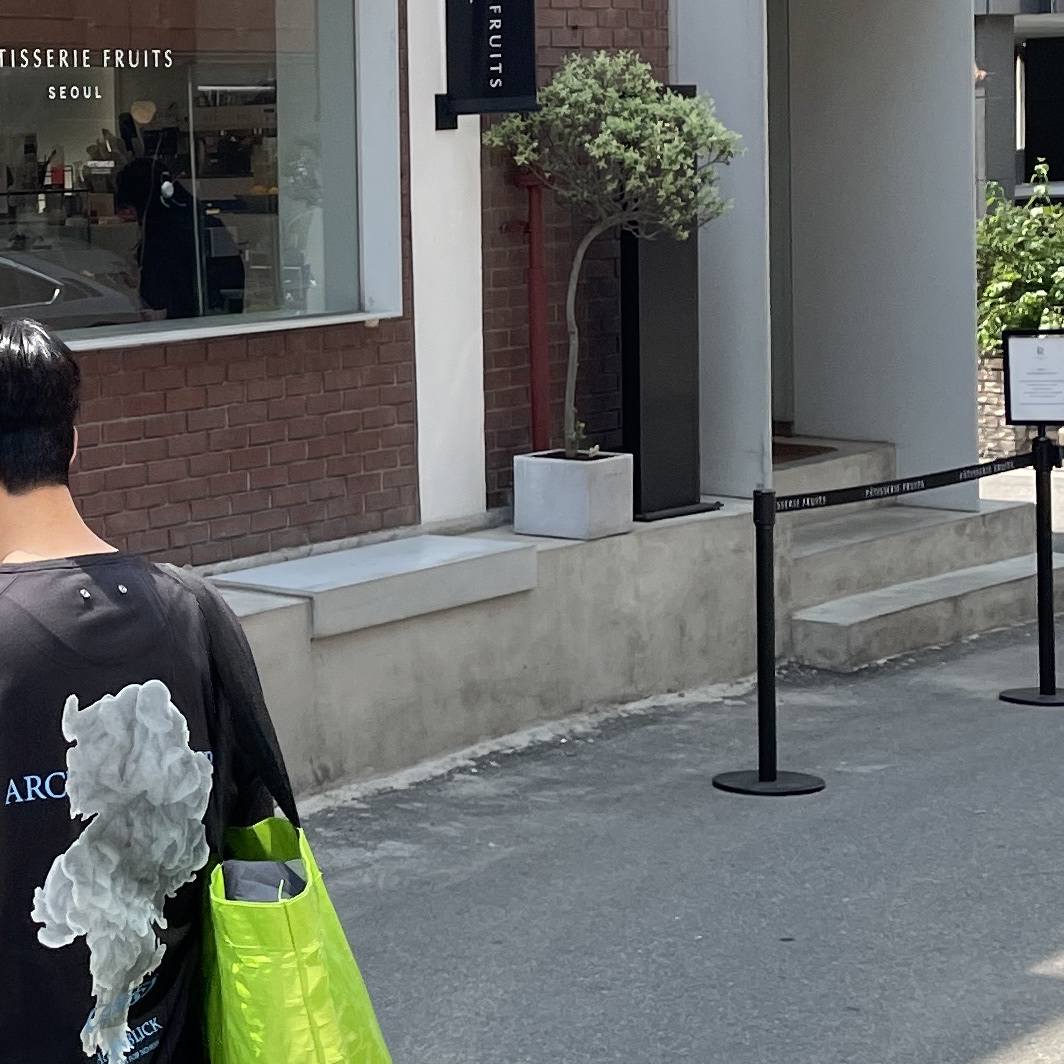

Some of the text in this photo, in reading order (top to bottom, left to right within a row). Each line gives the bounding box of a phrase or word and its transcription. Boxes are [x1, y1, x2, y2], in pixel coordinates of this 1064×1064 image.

[488, 5, 503, 89] FRUITS
[103, 49, 174, 68] FRUITS
[48, 85, 102, 100] SEOUL
